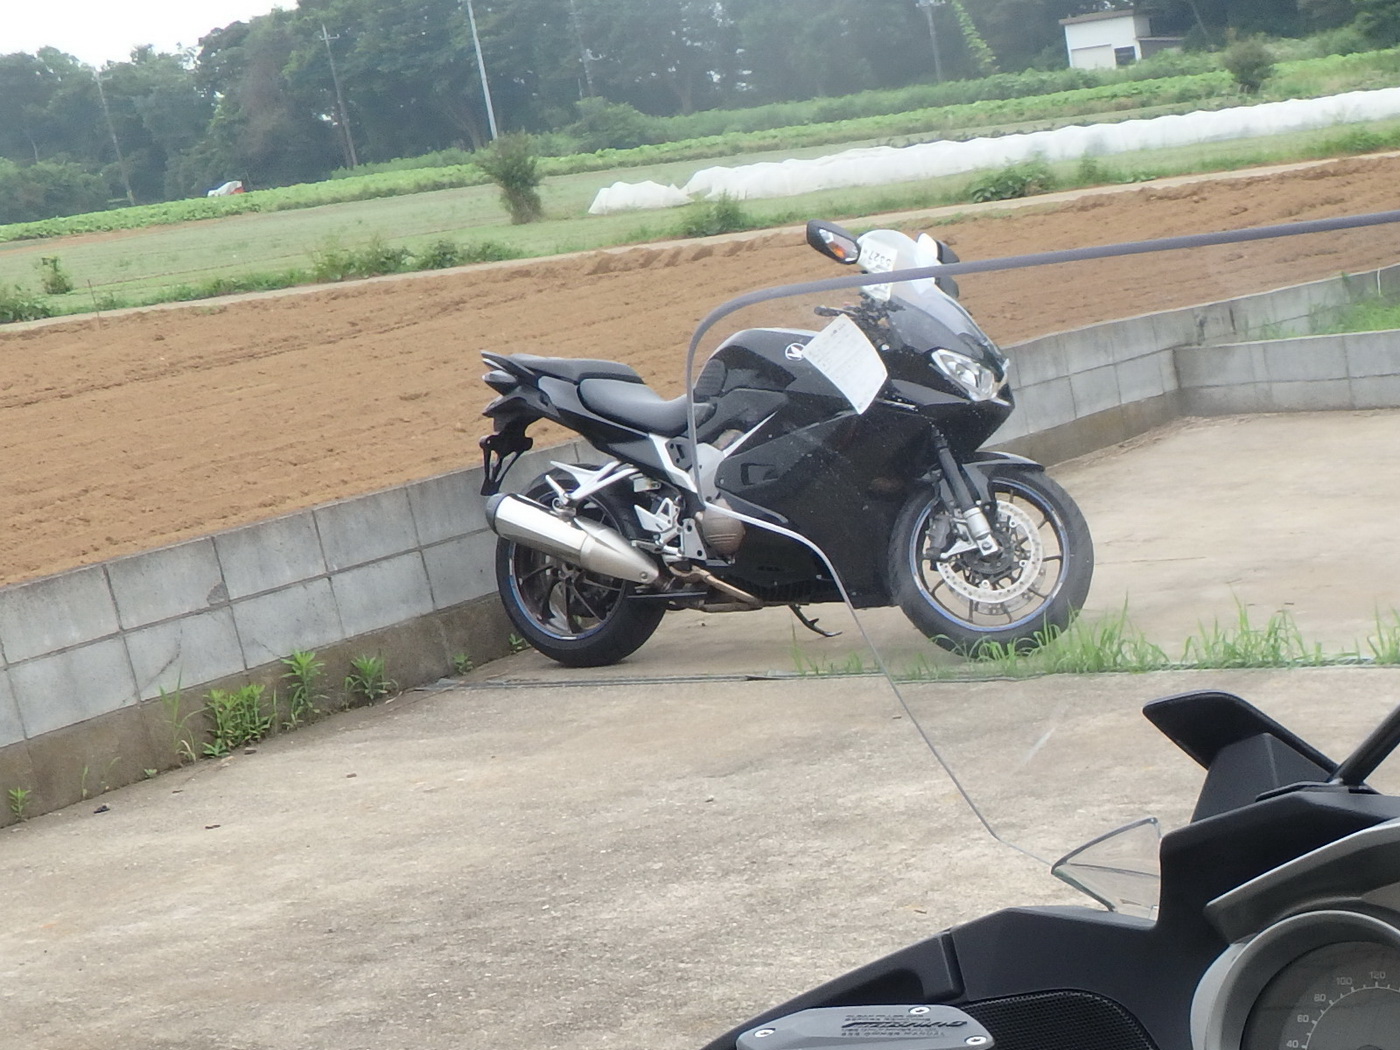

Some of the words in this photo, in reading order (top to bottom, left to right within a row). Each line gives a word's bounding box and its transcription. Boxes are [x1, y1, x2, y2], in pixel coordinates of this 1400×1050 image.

[1369, 971, 1386, 979] 120
[1336, 976, 1353, 985] 100
[1313, 993, 1327, 1002] 80
[1297, 1014, 1310, 1023] 60
[1286, 1039, 1299, 1048] 40
